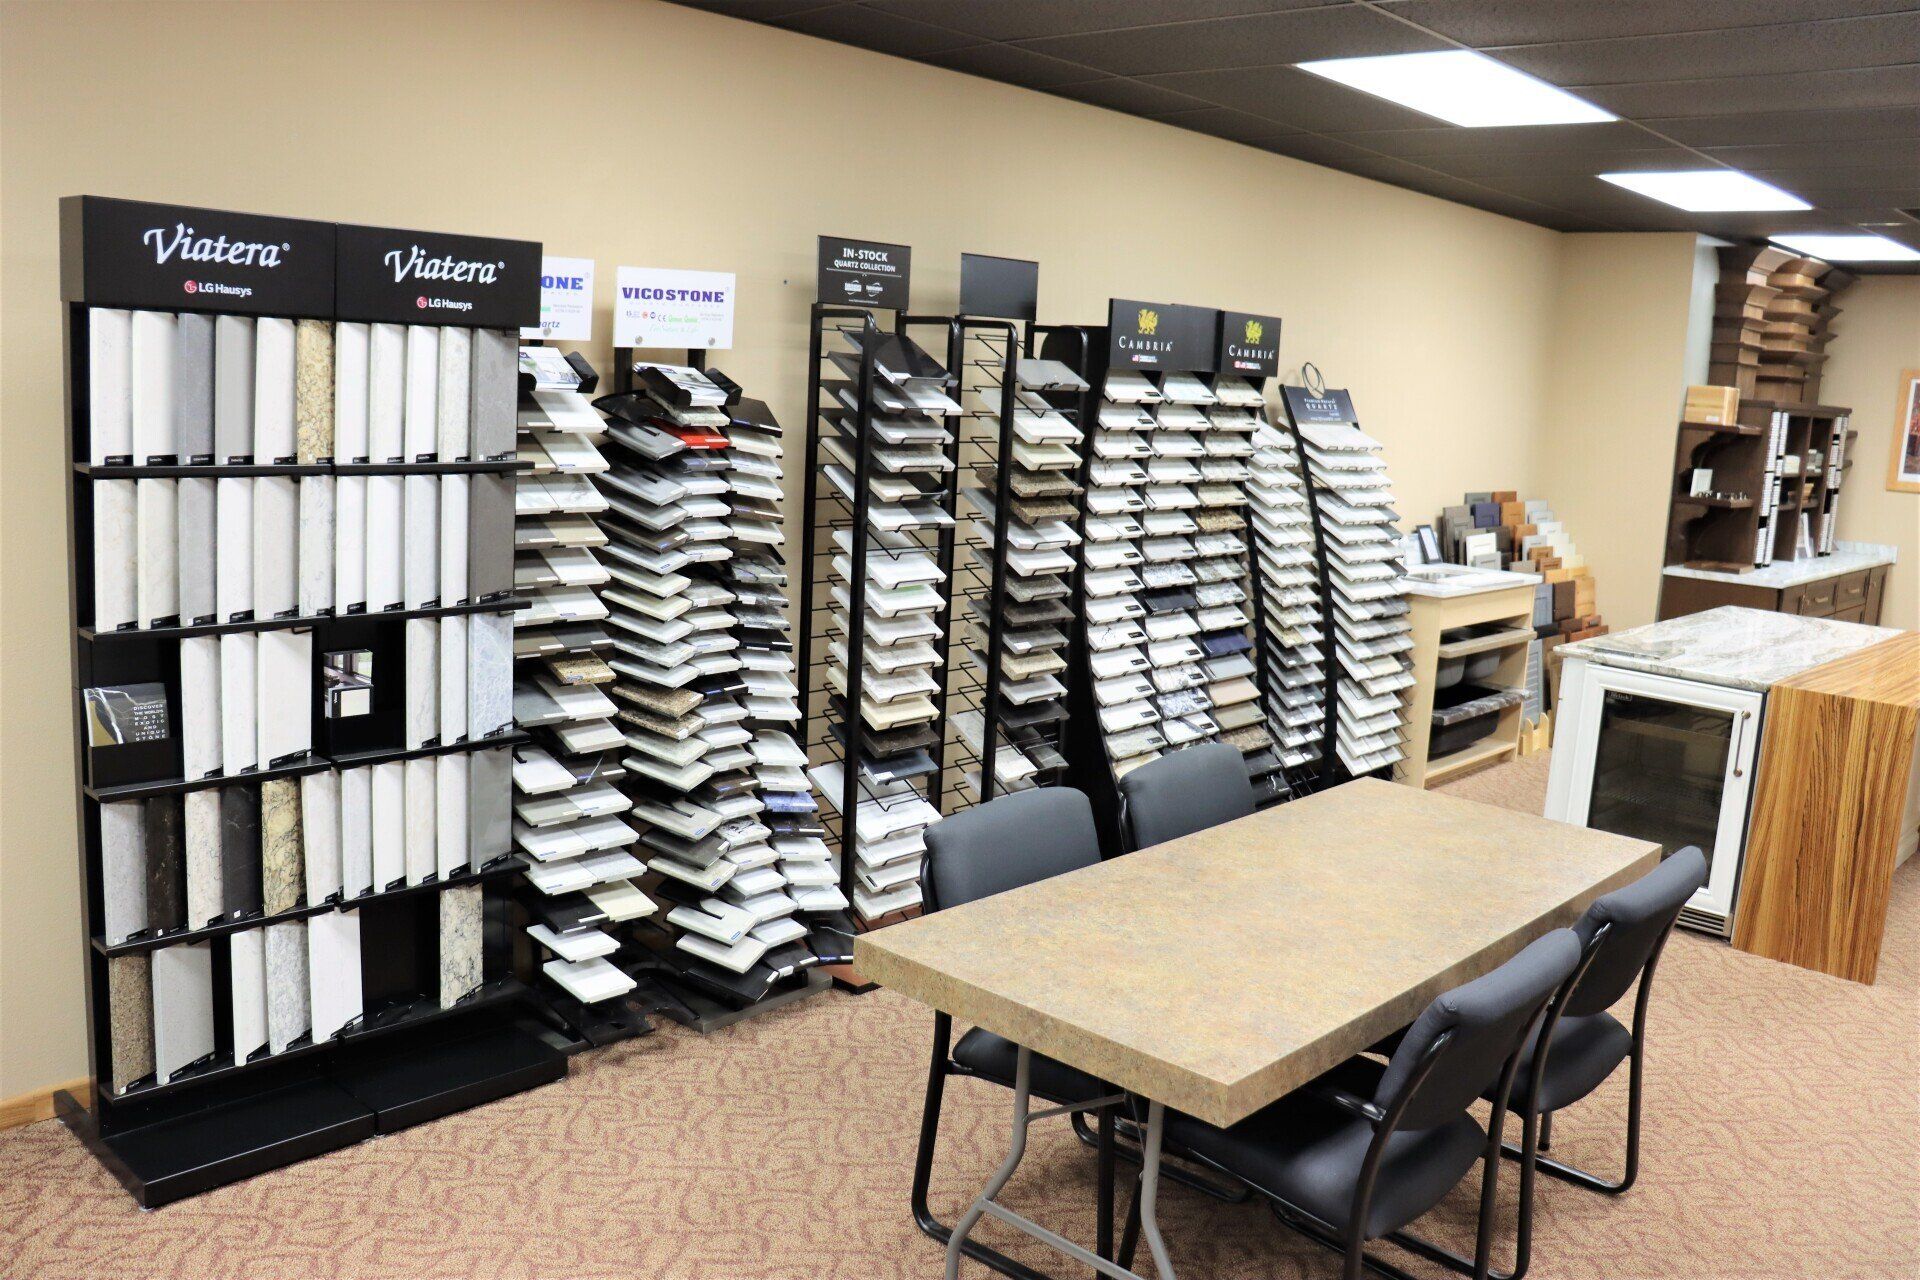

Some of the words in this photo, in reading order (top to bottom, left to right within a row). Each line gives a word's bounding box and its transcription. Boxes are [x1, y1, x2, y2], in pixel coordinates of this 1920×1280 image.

[843, 248, 888, 262] IN-STOCK
[834, 259, 859, 269] QUARTZ
[859, 262, 896, 273] COLLECTION
[198, 282, 214, 293] LG
[215, 284, 252, 298] Hausys
[623, 288, 724, 303] VICOSTONE
[428, 298, 441, 309] LG
[442, 299, 473, 312] Hausys
[1118, 335, 1173, 352] CAMBRIA
[1228, 344, 1274, 360] CAMBRIA
